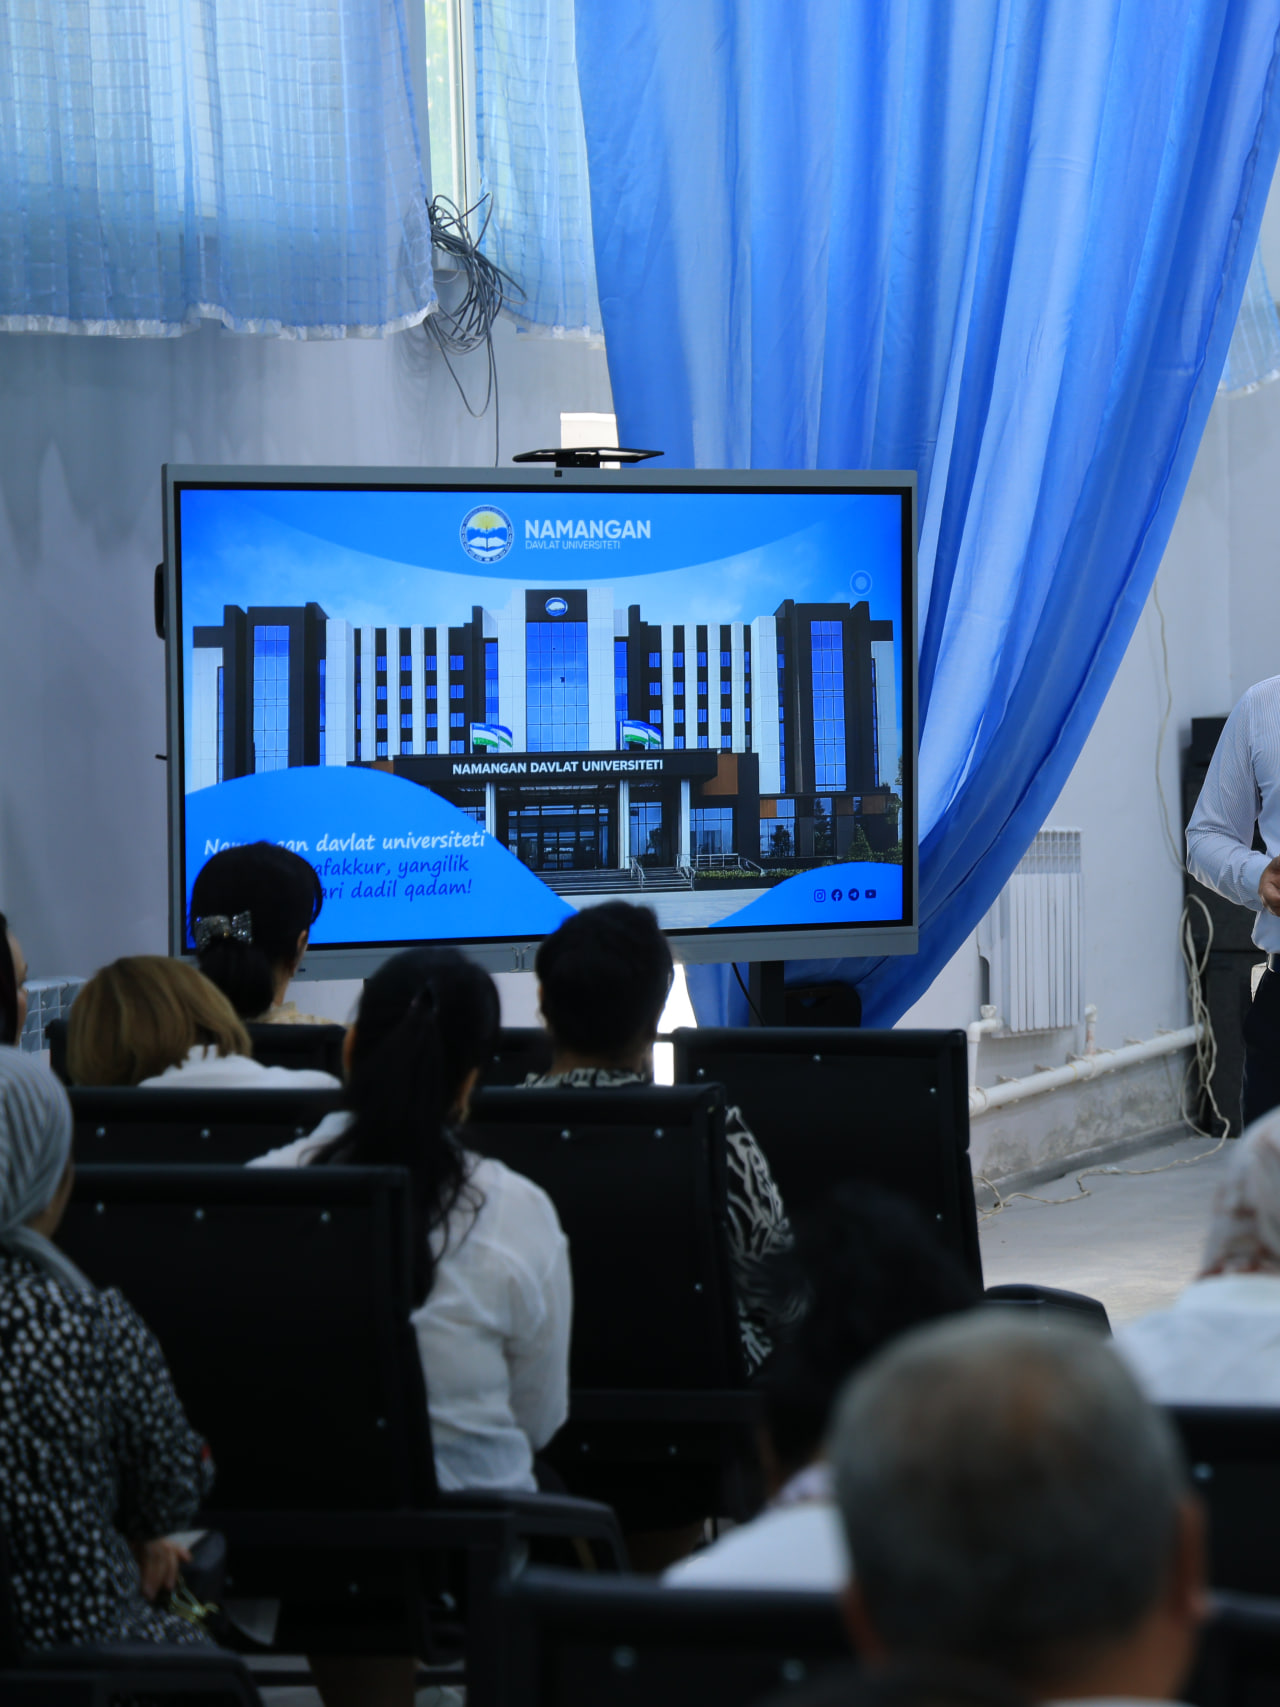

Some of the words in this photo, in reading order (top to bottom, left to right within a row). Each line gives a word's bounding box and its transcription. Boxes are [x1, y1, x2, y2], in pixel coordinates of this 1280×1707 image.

[524, 519, 651, 539] NAMANGAN
[525, 540, 560, 550] DAVLAT
[562, 540, 620, 550] UNIVERSITETI
[452, 762, 527, 775] NAMANGAN
[530, 761, 579, 773] DAVLAT
[582, 759, 663, 772] UNIVERSITETI
[316, 832, 375, 851] davlat
[382, 829, 486, 850] universiteti
[314, 857, 391, 876] afakkur,
[397, 854, 469, 879] yangilik
[351, 879, 397, 898] dadil
[404, 878, 473, 902] qadam!
